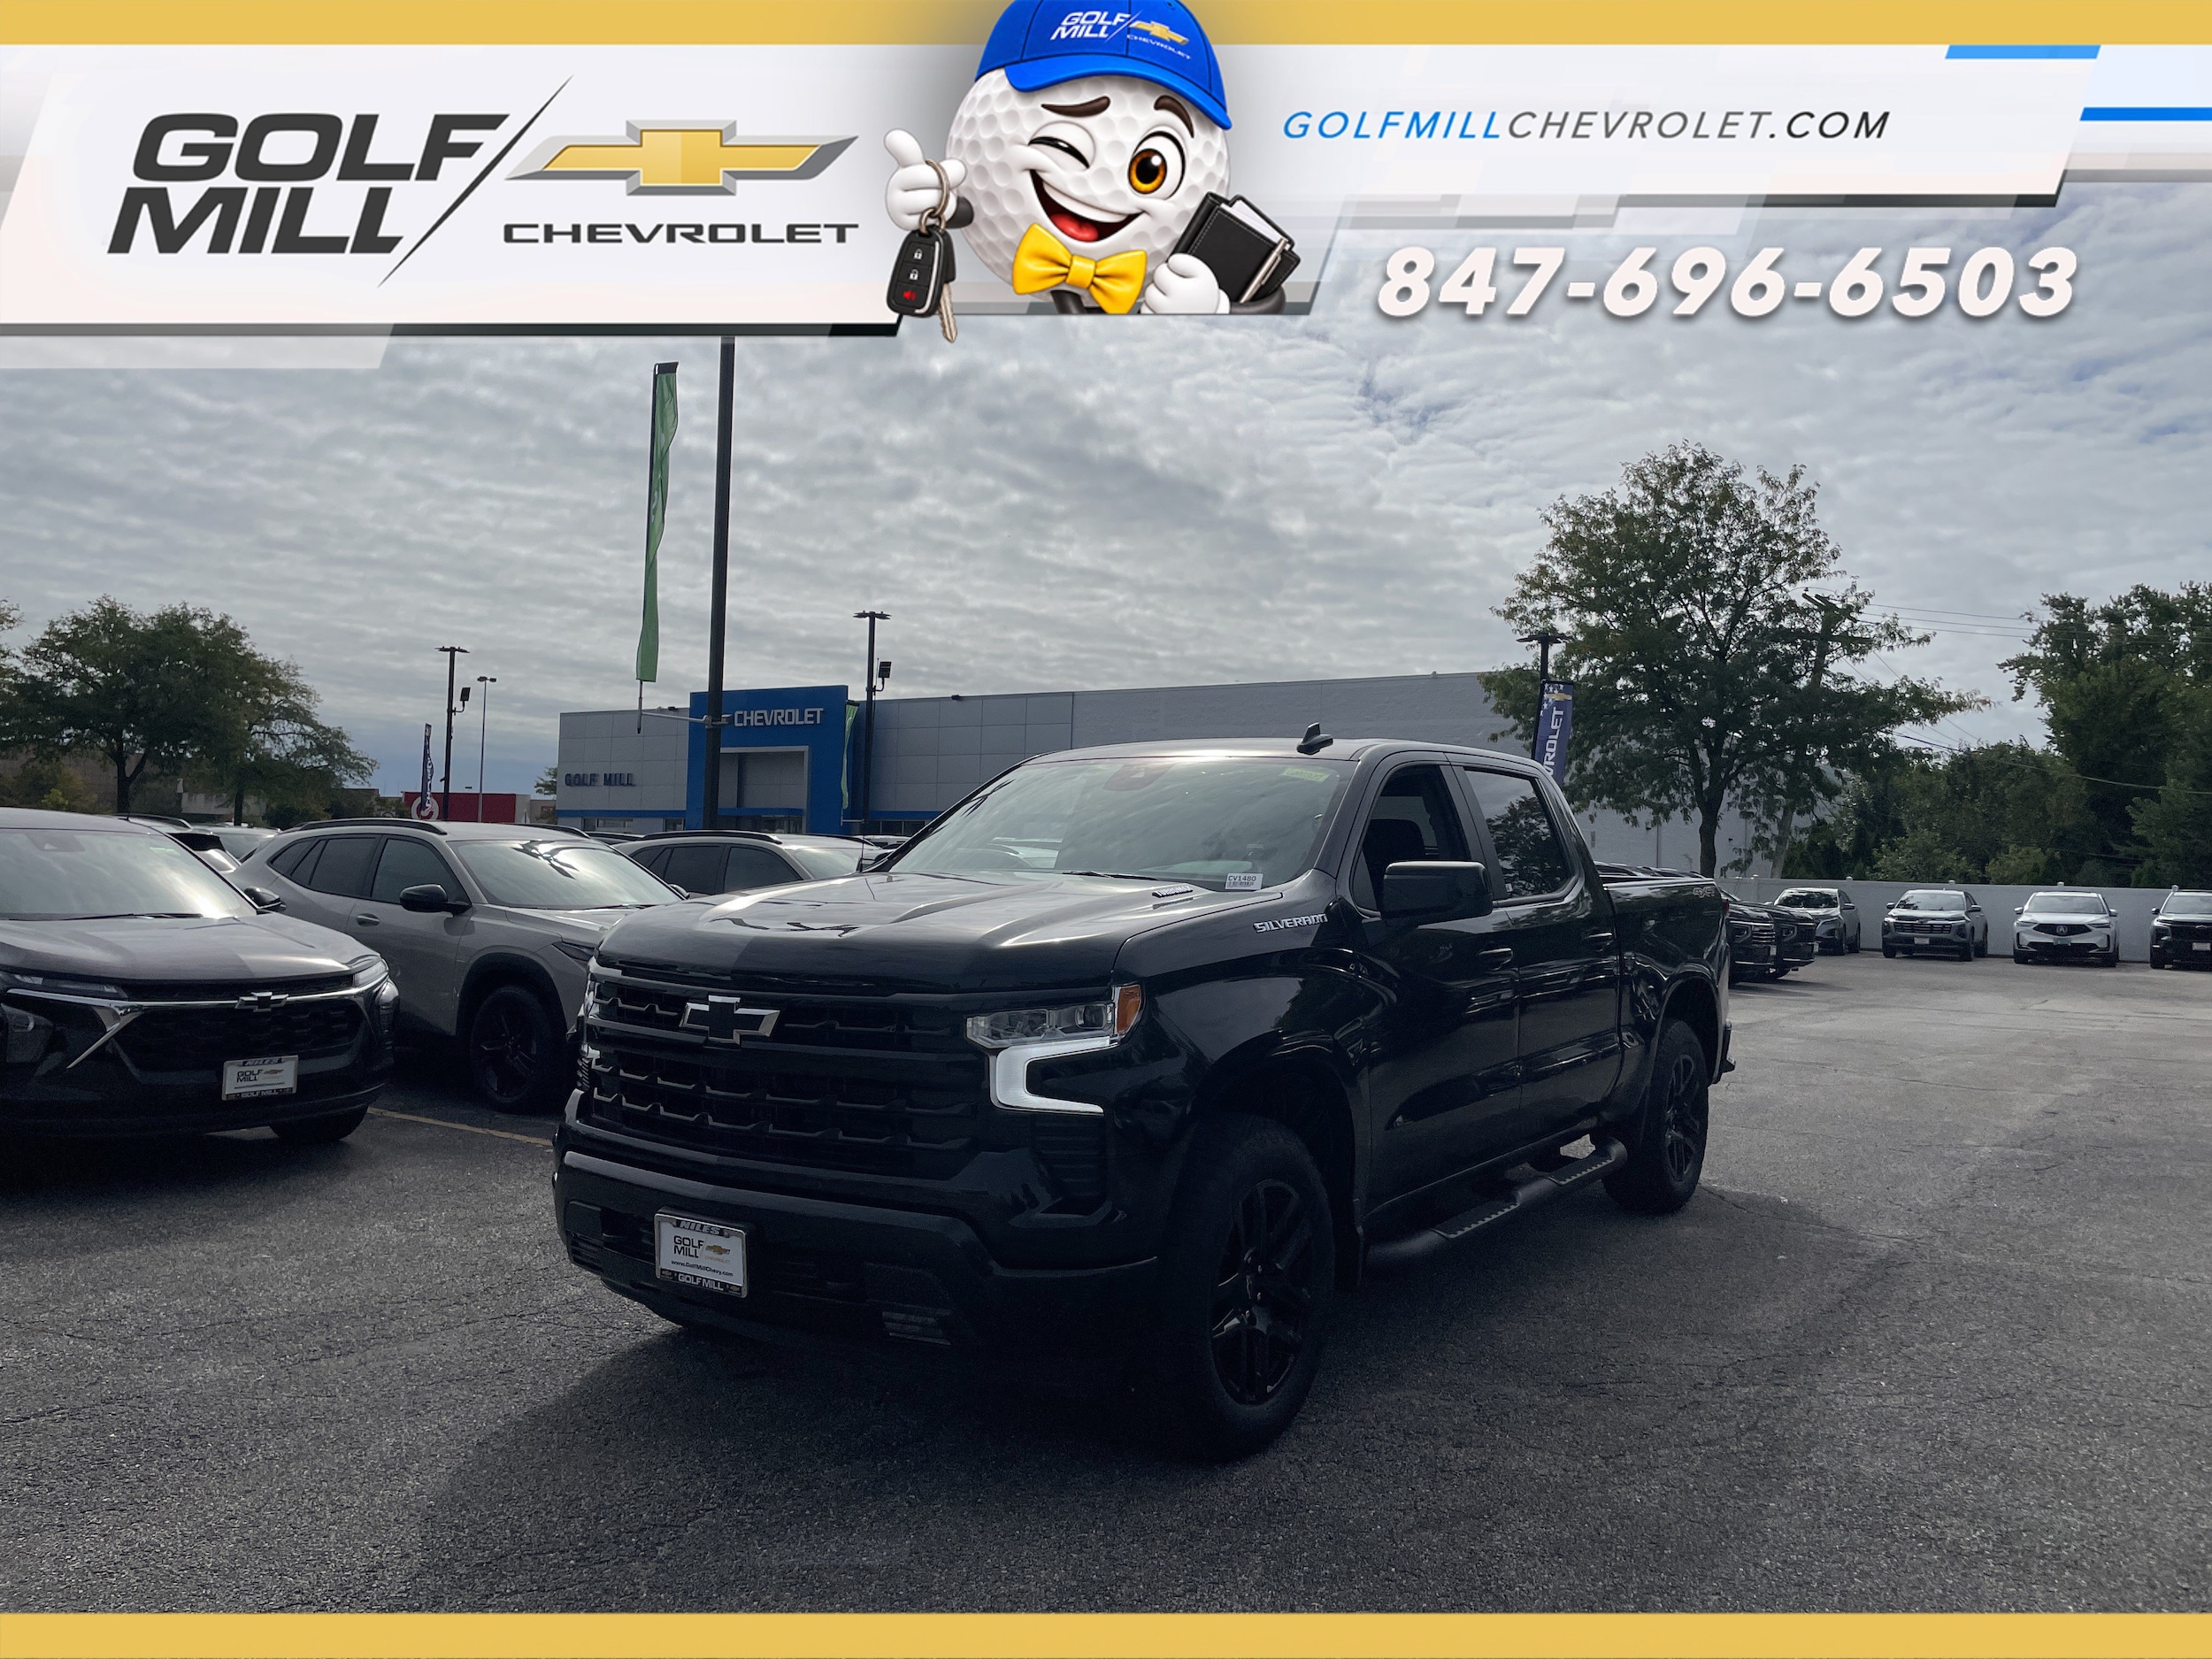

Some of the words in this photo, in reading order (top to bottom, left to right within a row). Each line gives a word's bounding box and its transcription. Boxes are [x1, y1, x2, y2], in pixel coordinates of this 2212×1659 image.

[733, 707, 825, 727] CHEVROLET
[565, 772, 599, 787] GOLF
[603, 772, 636, 787] MILL
[1253, 913, 1328, 933] SILVERADO
[680, 1220, 720, 1235] NILES
[673, 1235, 704, 1248] GOLF
[673, 1246, 699, 1258] MILL
[671, 1261, 733, 1277] www.GolfMillChevy.com
[678, 1273, 702, 1286] GOLF
[702, 1278, 724, 1292] MILL
